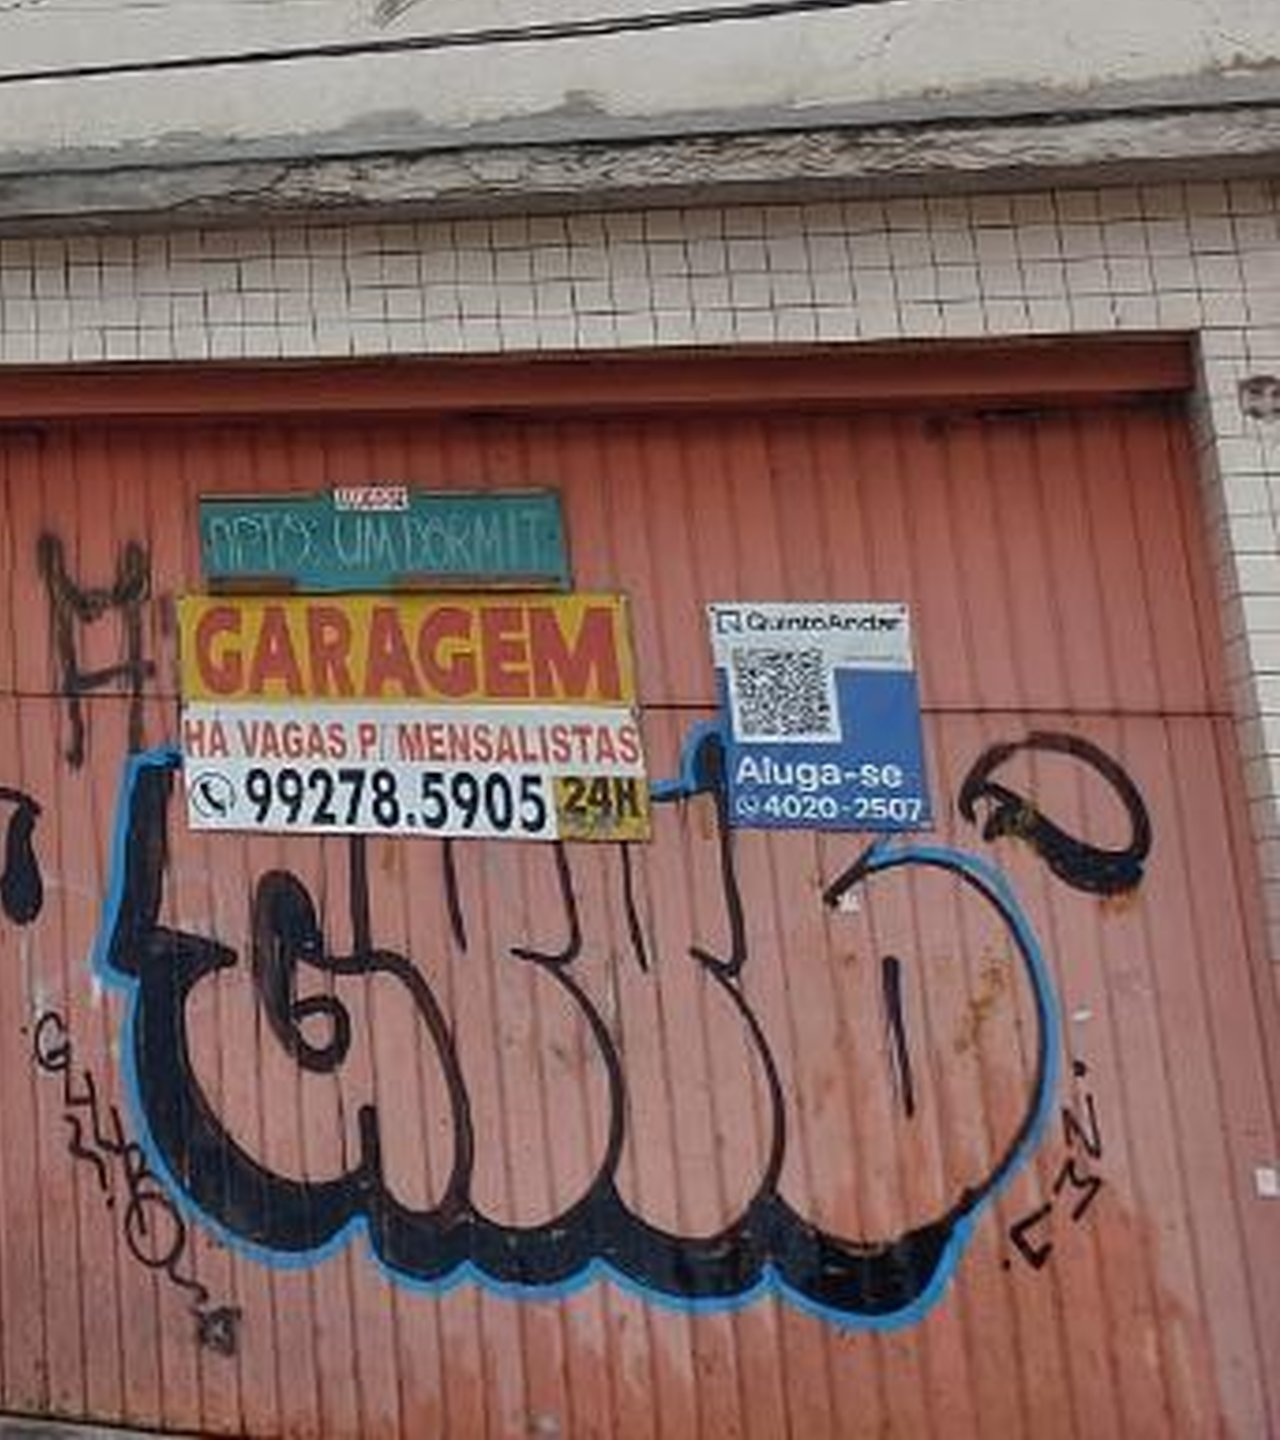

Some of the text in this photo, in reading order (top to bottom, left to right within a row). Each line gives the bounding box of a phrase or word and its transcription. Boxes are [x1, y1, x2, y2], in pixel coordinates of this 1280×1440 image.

[194, 603, 624, 701] GARAGEM
[239, 720, 347, 759] VAGAS
[397, 722, 640, 766] MENSALISTAS
[735, 755, 905, 793] Aluga-se
[245, 766, 640, 833] 99278.5905 24H
[763, 793, 924, 823] 4020-2507
